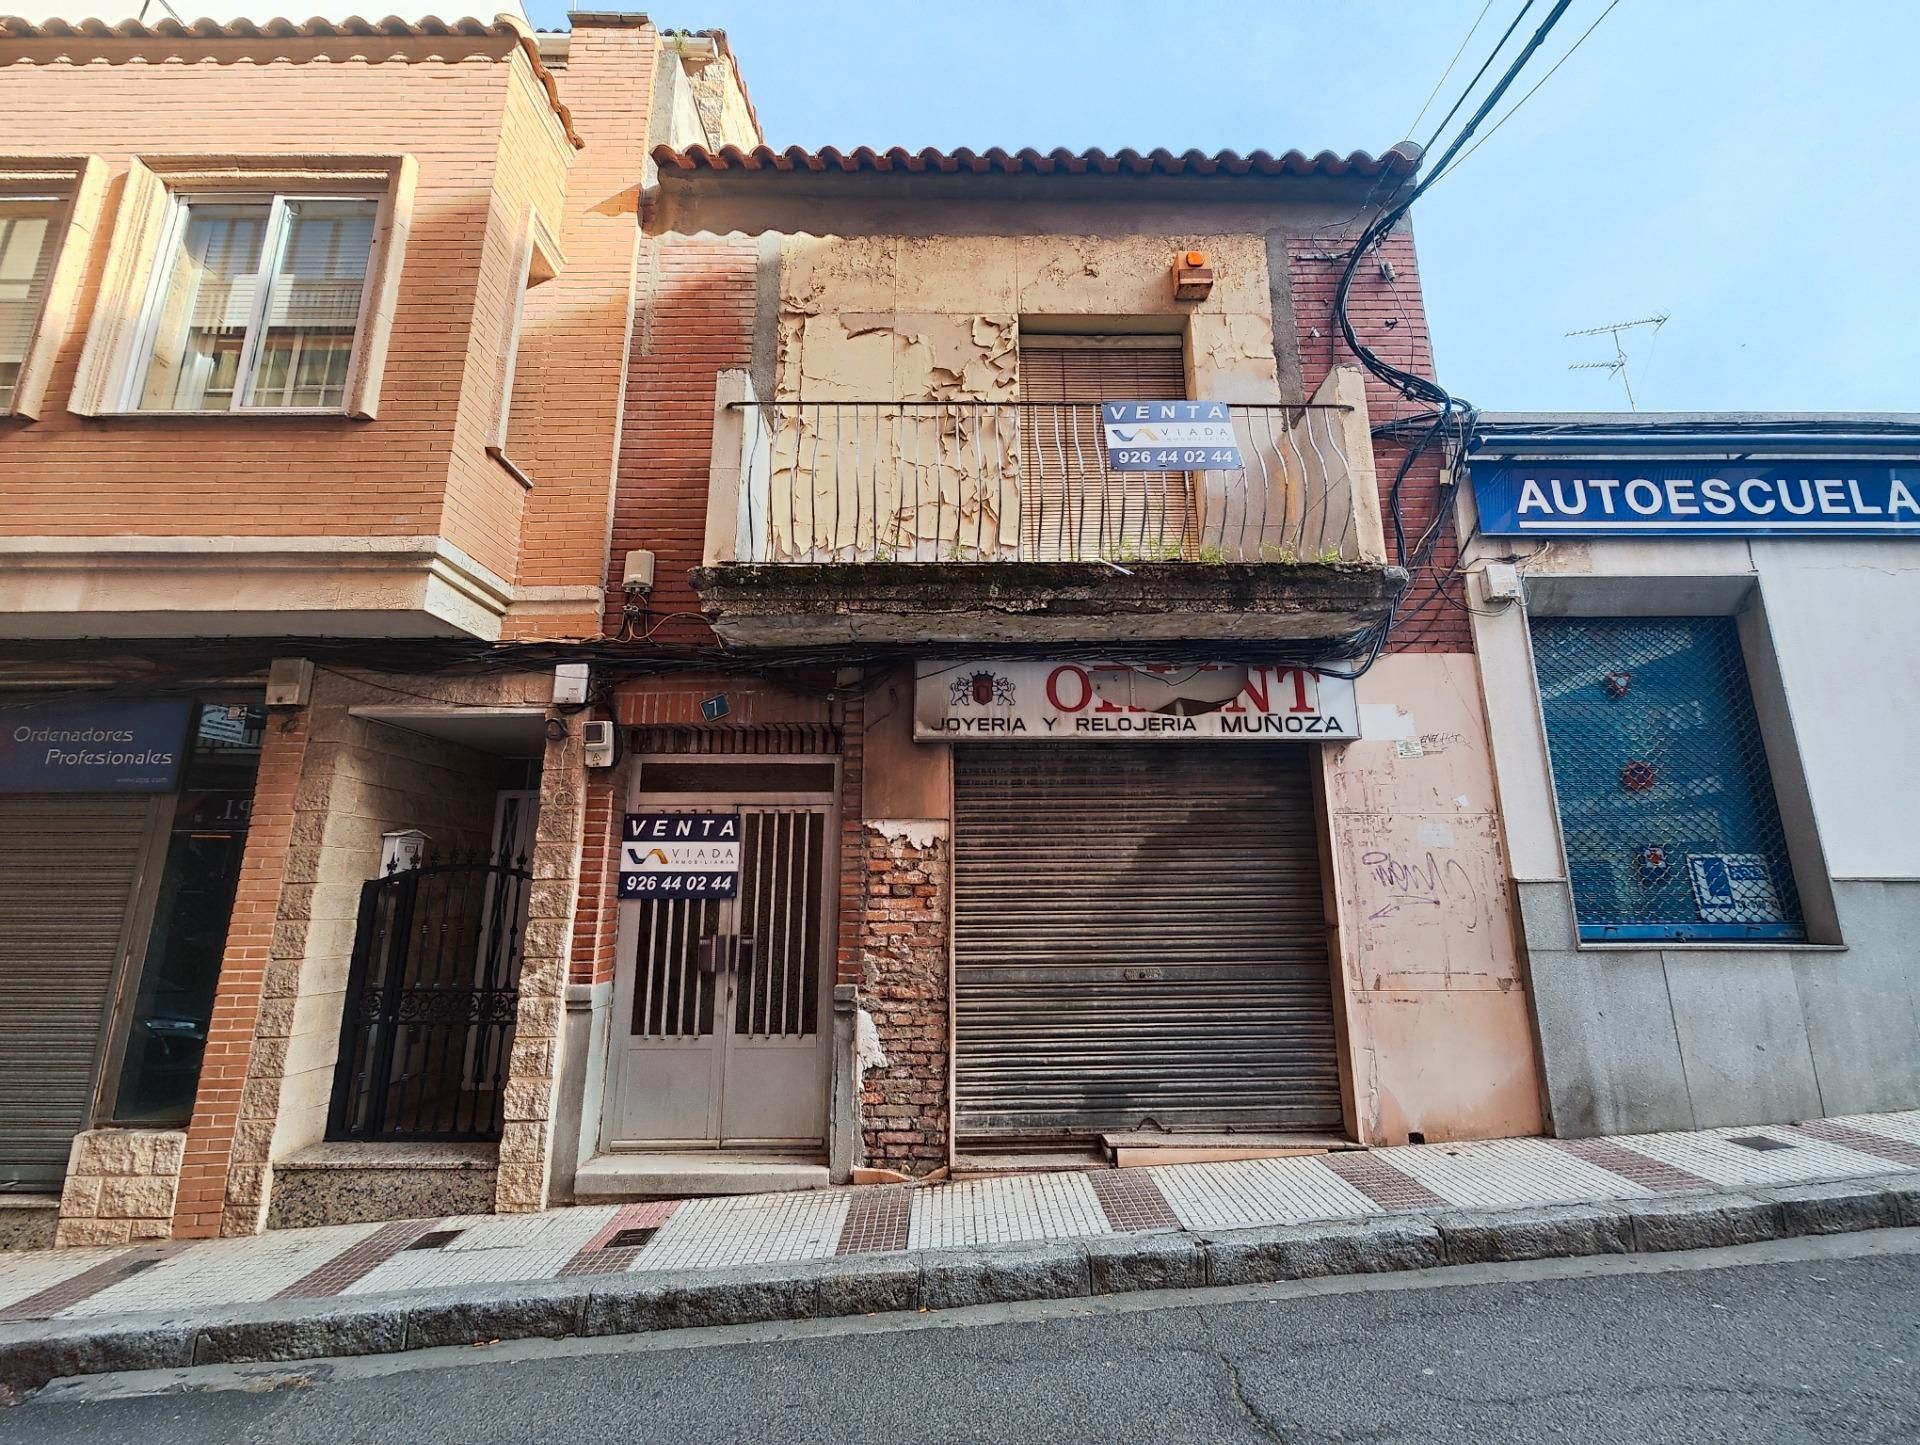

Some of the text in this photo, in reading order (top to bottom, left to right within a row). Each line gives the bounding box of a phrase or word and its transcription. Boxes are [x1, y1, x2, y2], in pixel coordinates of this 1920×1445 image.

[1110, 405, 1223, 420] VENTA
[1161, 427, 1228, 436] VIADA
[1118, 450, 1233, 464] 926 44 02 44
[1517, 478, 1920, 515] AUTOESCUELA
[708, 700, 717, 716] 7
[931, 713, 1344, 733] JOYERIA Y RELOJERIA MUÑOZA
[14, 726, 134, 743] Ordenadores
[45, 749, 173, 765] Profesionales
[631, 820, 735, 837] VENTA
[672, 848, 734, 858] VIADA
[626, 875, 732, 891] 926 44 02 44
